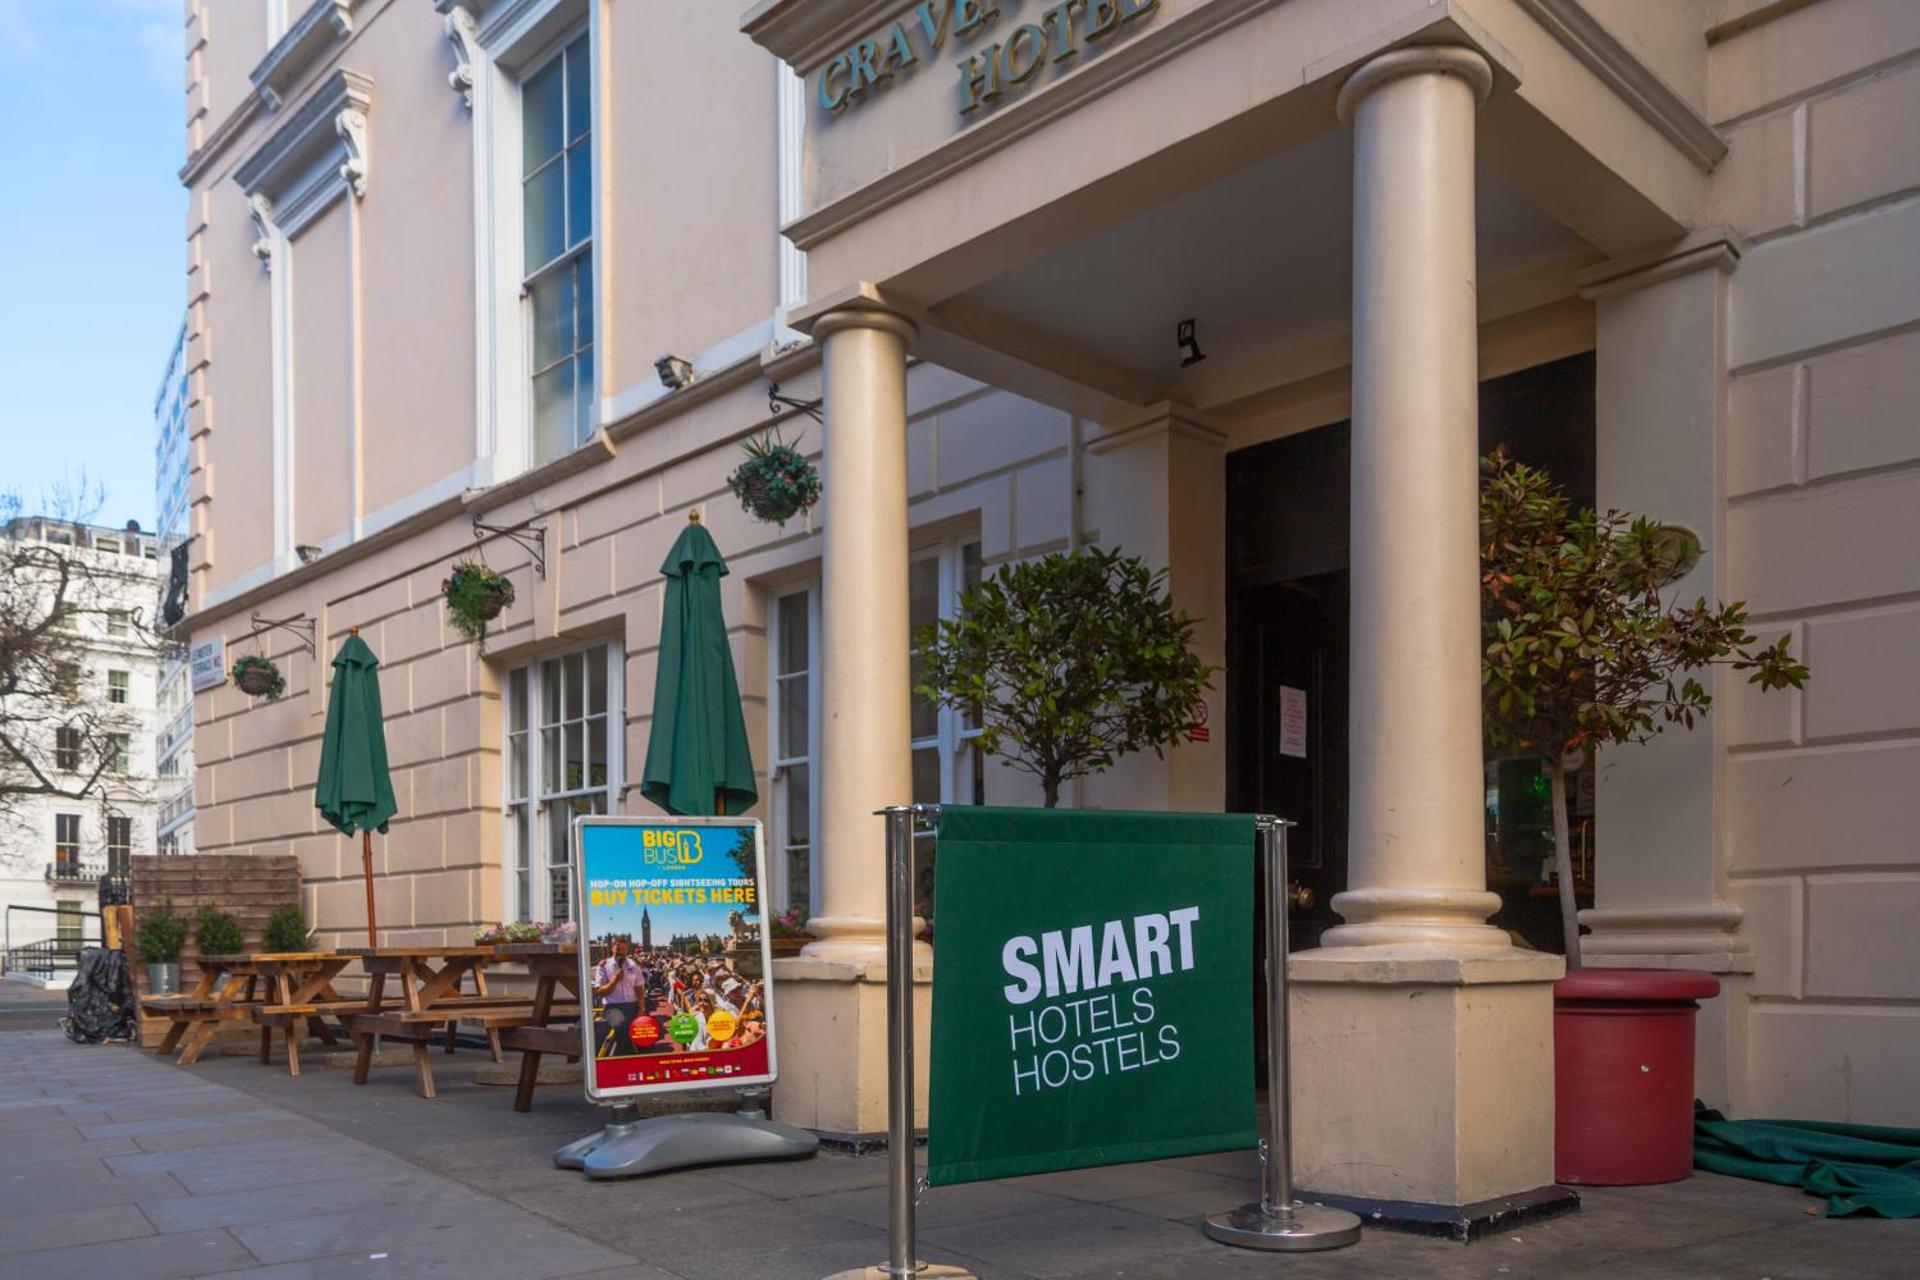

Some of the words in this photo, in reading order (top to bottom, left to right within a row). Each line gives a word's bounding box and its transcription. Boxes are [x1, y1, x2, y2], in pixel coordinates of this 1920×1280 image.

[817, 0, 1000, 113] CRAVE
[643, 830, 675, 848] BIG
[644, 848, 677, 864] BUS
[590, 879, 626, 888] HOP-ON
[629, 878, 669, 888] HOP-OFF
[670, 878, 726, 887] SIGHTSEEING
[728, 878, 755, 887] TOURS
[591, 889, 627, 907] BUY
[633, 888, 707, 905] TICKETS
[711, 887, 755, 904] HERE
[1002, 906, 1200, 1004] SMART
[1009, 987, 1155, 1051] HOTELS
[1013, 1024, 1180, 1096] HOSTELS
